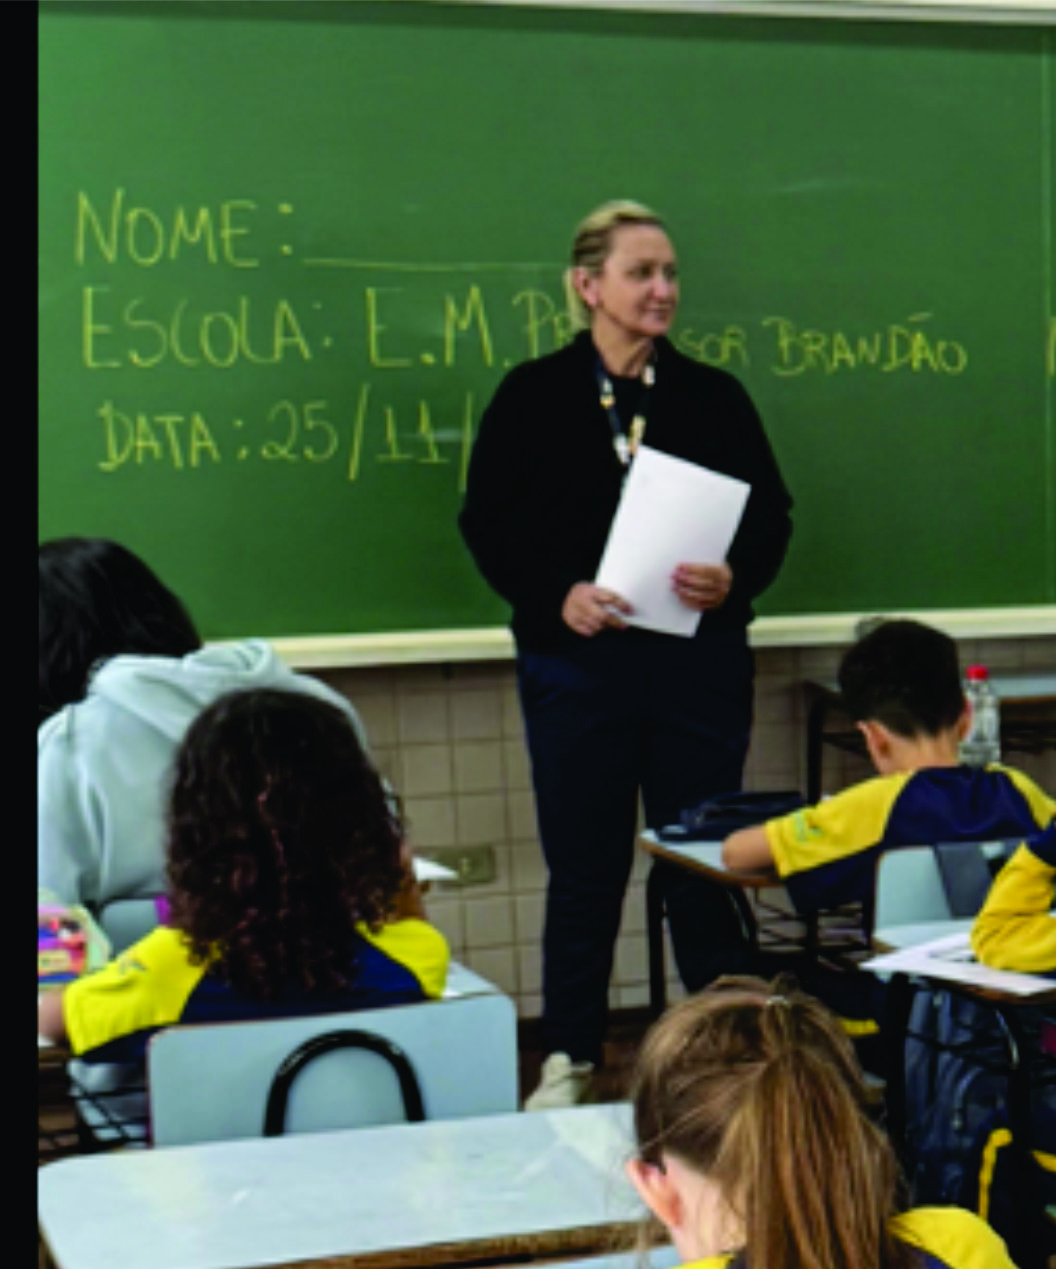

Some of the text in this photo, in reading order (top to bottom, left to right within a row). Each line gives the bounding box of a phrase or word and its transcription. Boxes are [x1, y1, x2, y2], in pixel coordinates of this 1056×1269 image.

[82, 286, 333, 367] ESCOLA:
[762, 312, 968, 376] BRANDÃO
[97, 401, 248, 471] DATA:
